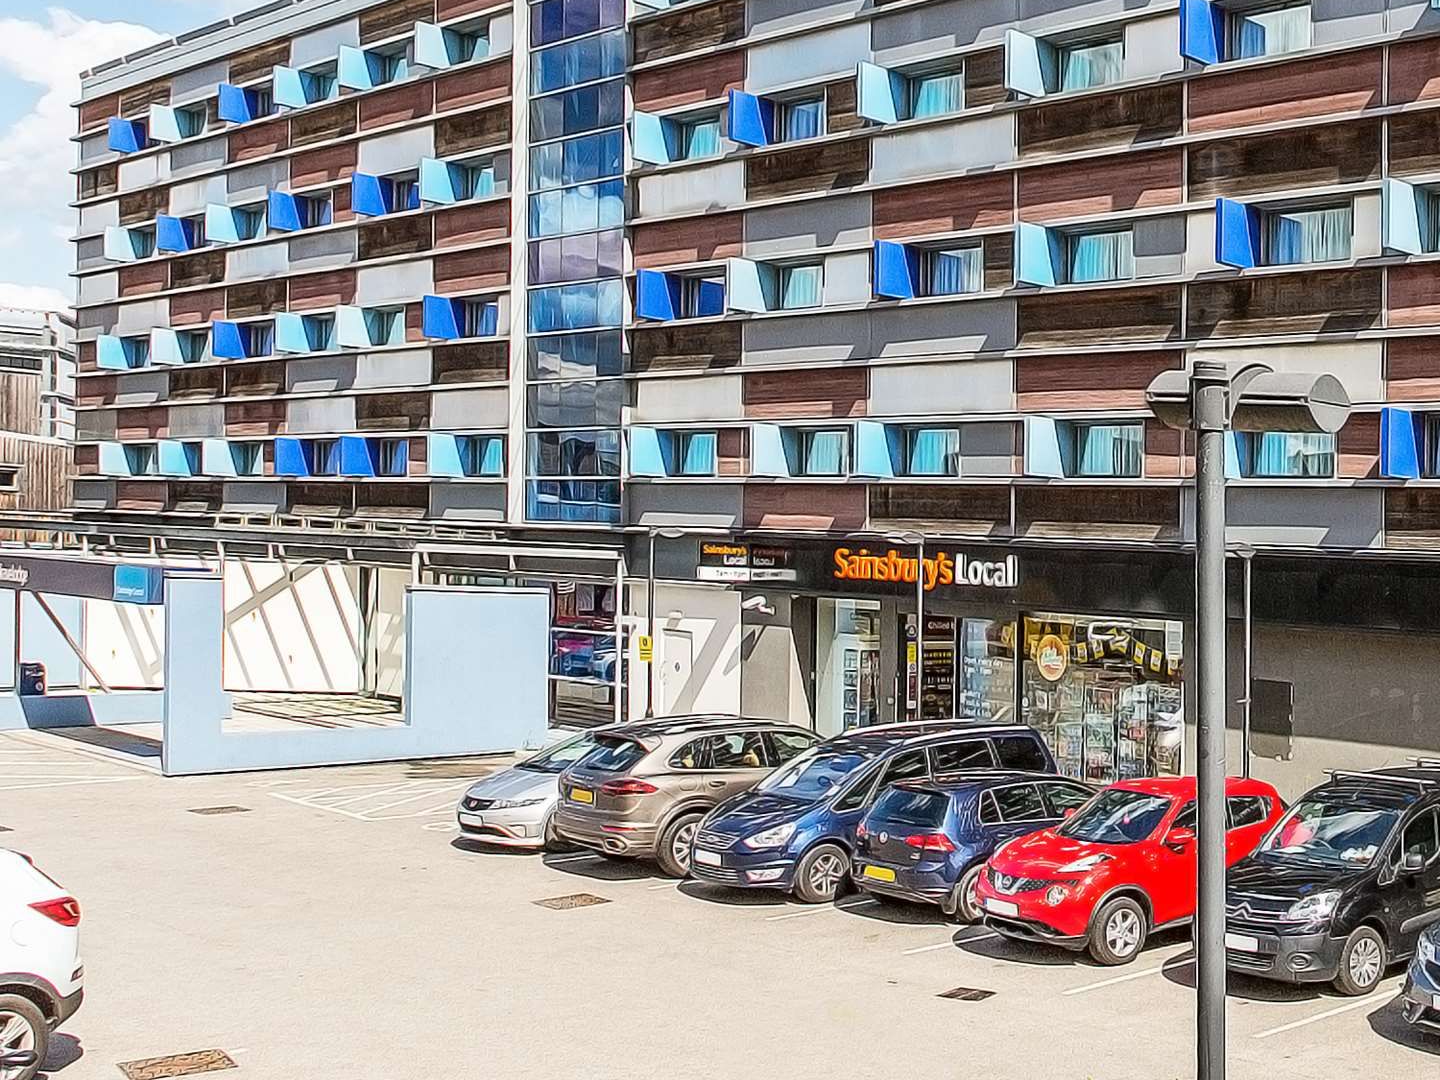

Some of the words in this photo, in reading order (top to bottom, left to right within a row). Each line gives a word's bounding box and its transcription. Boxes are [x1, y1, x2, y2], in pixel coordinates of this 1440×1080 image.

[703, 545, 747, 556] Sainsbury's
[724, 554, 747, 565] Local
[954, 553, 1018, 587] Local
